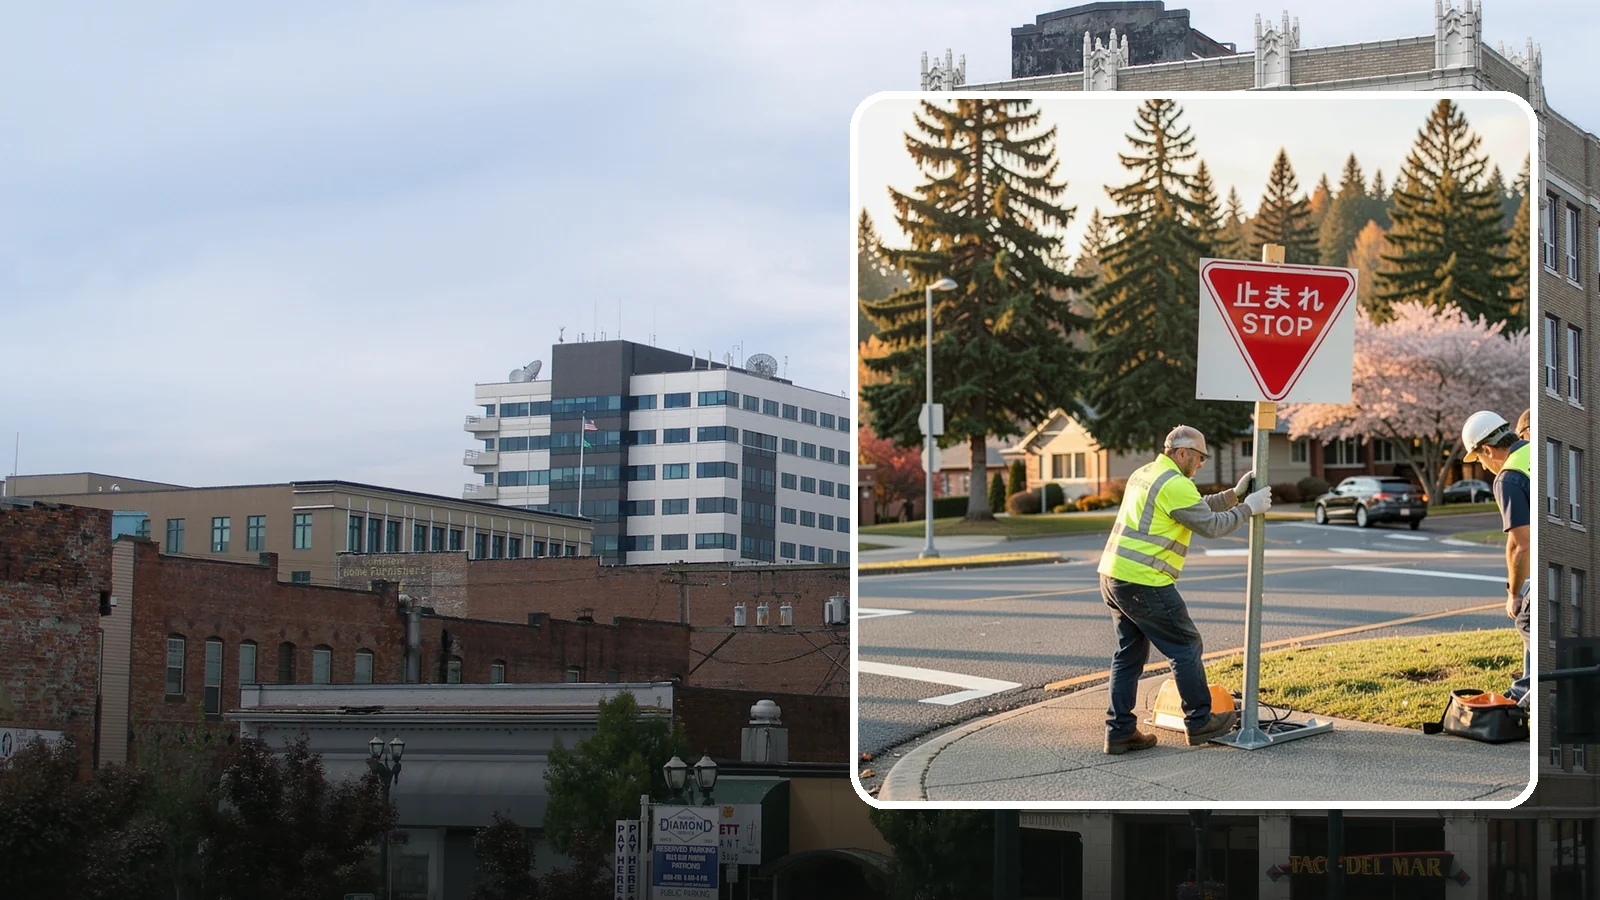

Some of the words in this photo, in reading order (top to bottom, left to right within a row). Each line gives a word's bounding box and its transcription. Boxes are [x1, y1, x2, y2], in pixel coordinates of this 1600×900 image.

[1233, 281, 1324, 312] 止まれ
[1242, 313, 1312, 336] STOP
[370, 566, 426, 576] Furnishers
[660, 818, 712, 832] DIAMOND
[1022, 816, 1070, 828] BUILDING
[720, 824, 740, 835] ETT
[720, 840, 740, 848] ANT
[1290, 856, 1328, 874] TAC
[1346, 856, 1384, 876] DEL
[1392, 857, 1442, 876] MAR
[660, 888, 682, 896] PUBLIC
[684, 890, 710, 898] PARKING
